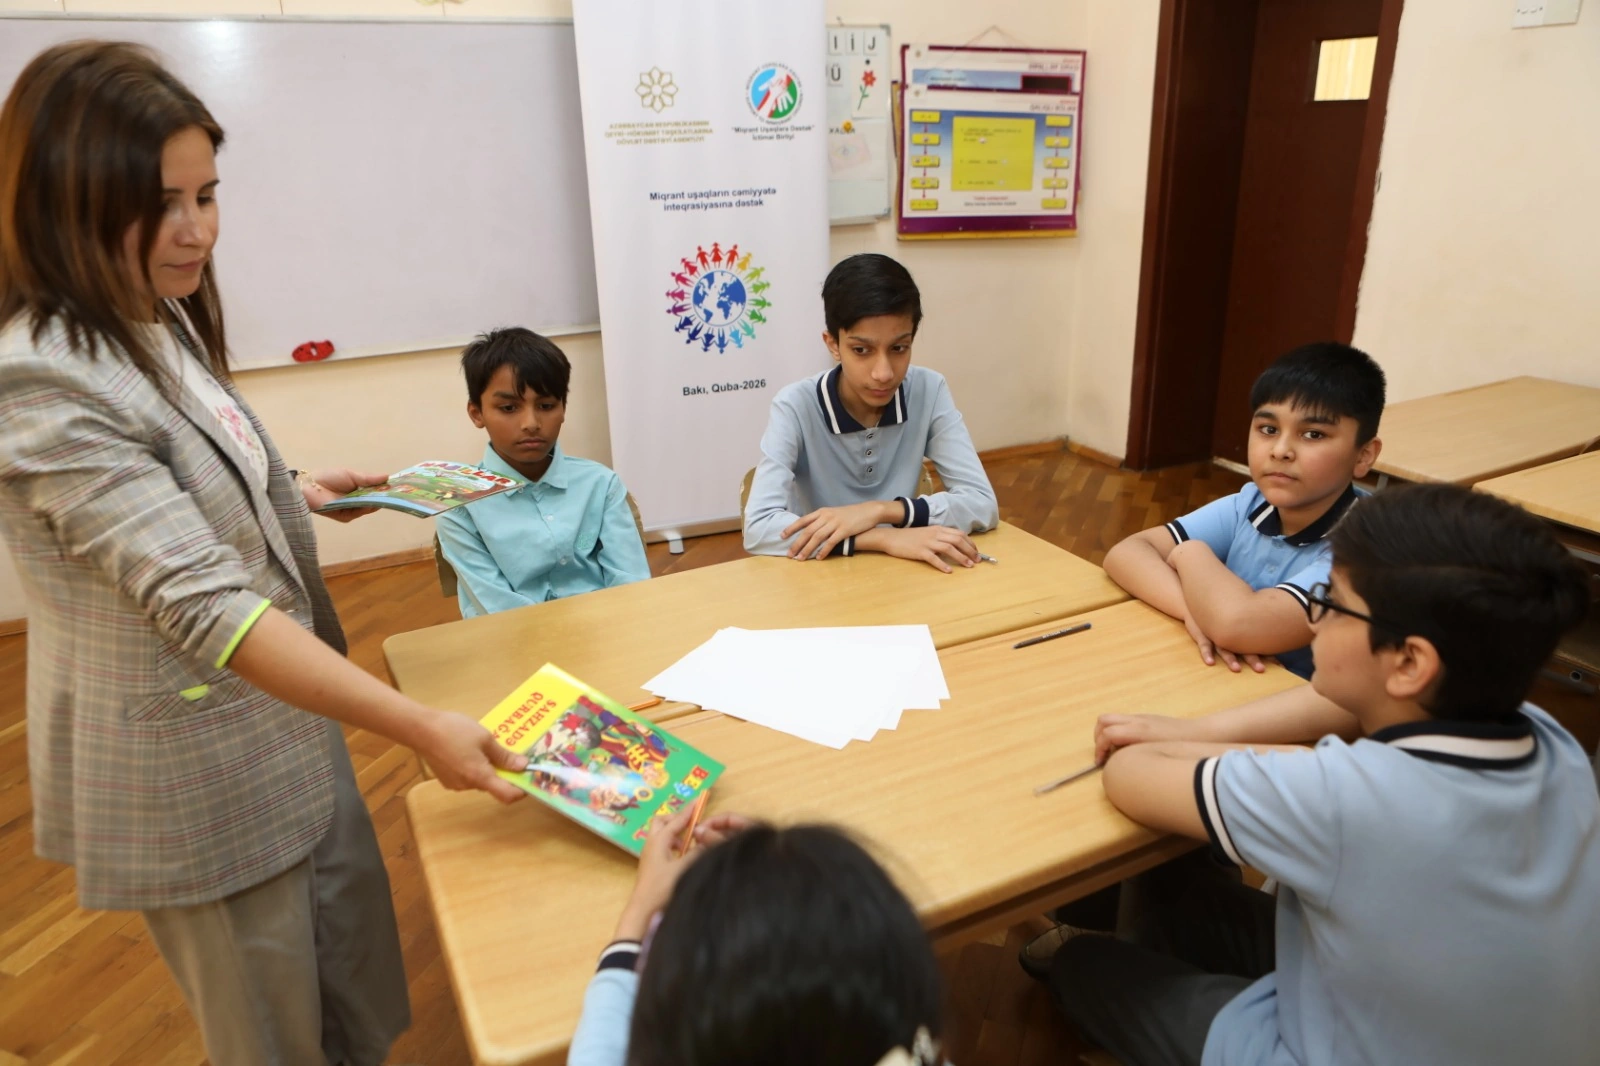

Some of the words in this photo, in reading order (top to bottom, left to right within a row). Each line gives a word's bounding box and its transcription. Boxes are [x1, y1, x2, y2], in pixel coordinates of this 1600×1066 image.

[867, 36, 876, 50] J
[830, 63, 841, 82] Ü
[649, 191, 685, 201] Miqrant
[687, 188, 730, 200] uşaqların
[732, 187, 777, 197] cəmiyyətə
[663, 200, 734, 212] inteqrasiyasına
[735, 198, 764, 208] dəstək
[682, 385, 709, 396] Bakı,
[711, 378, 767, 393] Quba-2026
[673, 765, 709, 798] BEŞ
